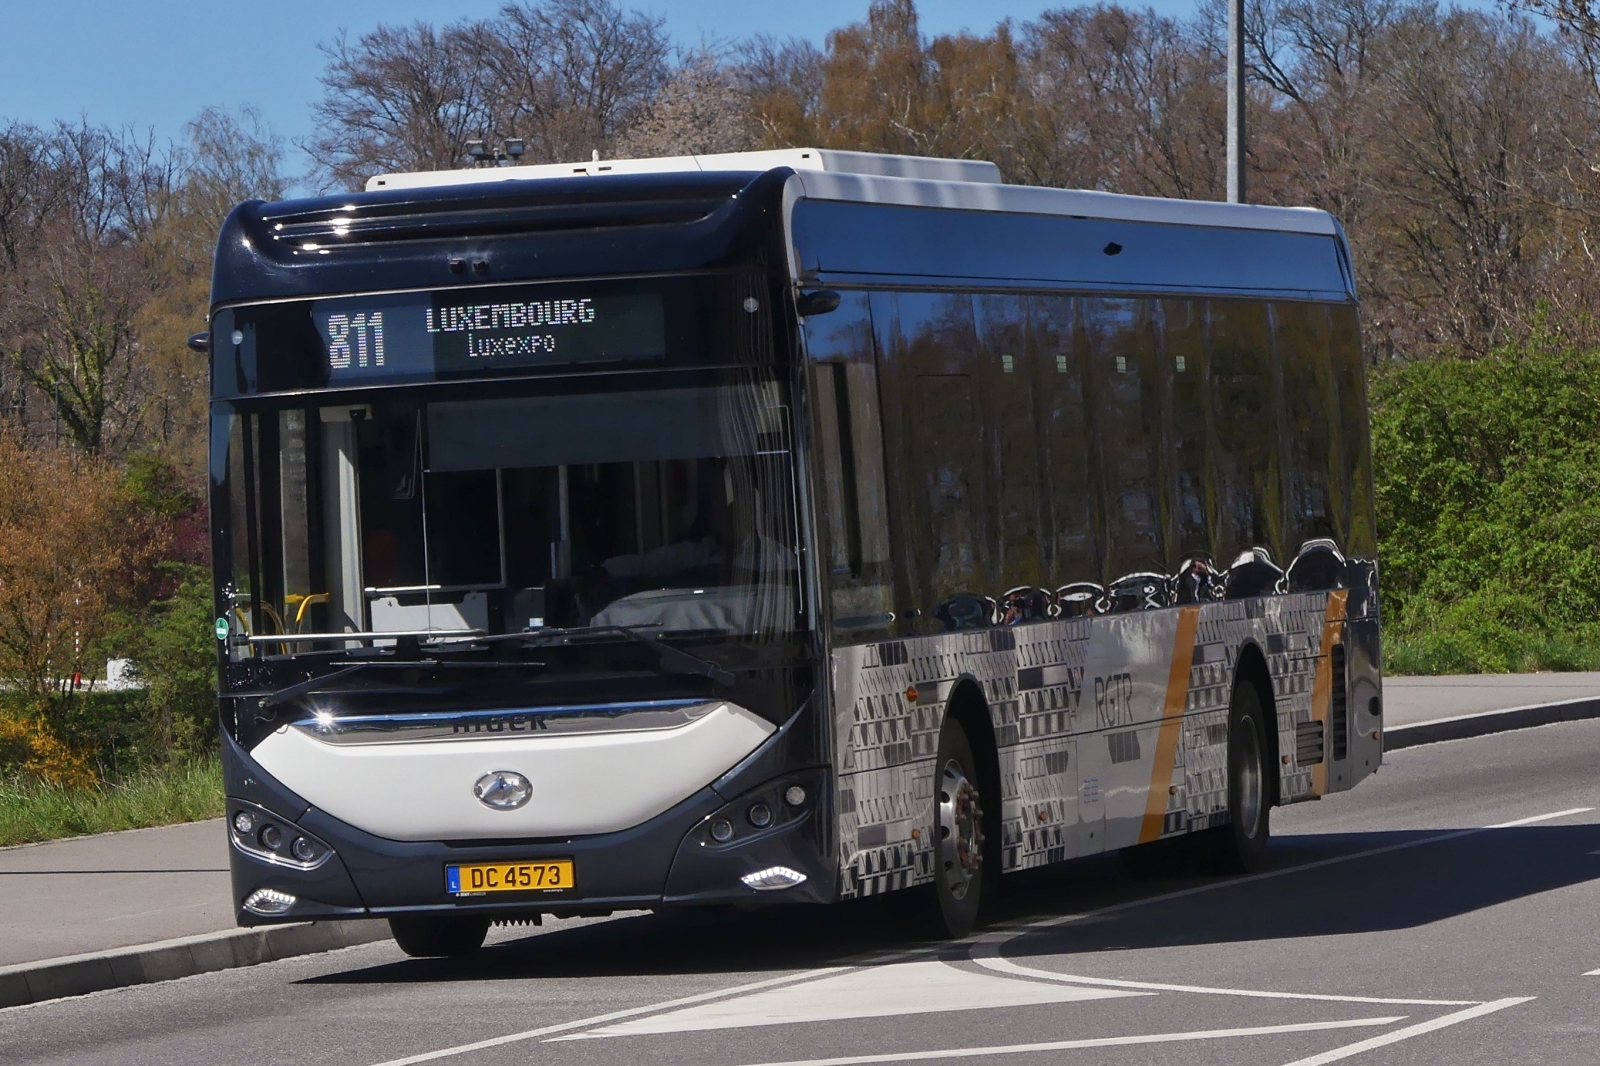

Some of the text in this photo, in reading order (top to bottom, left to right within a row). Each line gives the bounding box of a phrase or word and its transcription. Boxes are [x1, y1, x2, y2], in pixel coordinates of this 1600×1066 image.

[426, 298, 596, 333] LUXEMBOURG
[327, 312, 385, 369] 811
[1094, 673, 1134, 728] RGTR
[452, 713, 548, 733] HIGER
[451, 865, 561, 889] L DC 4573
